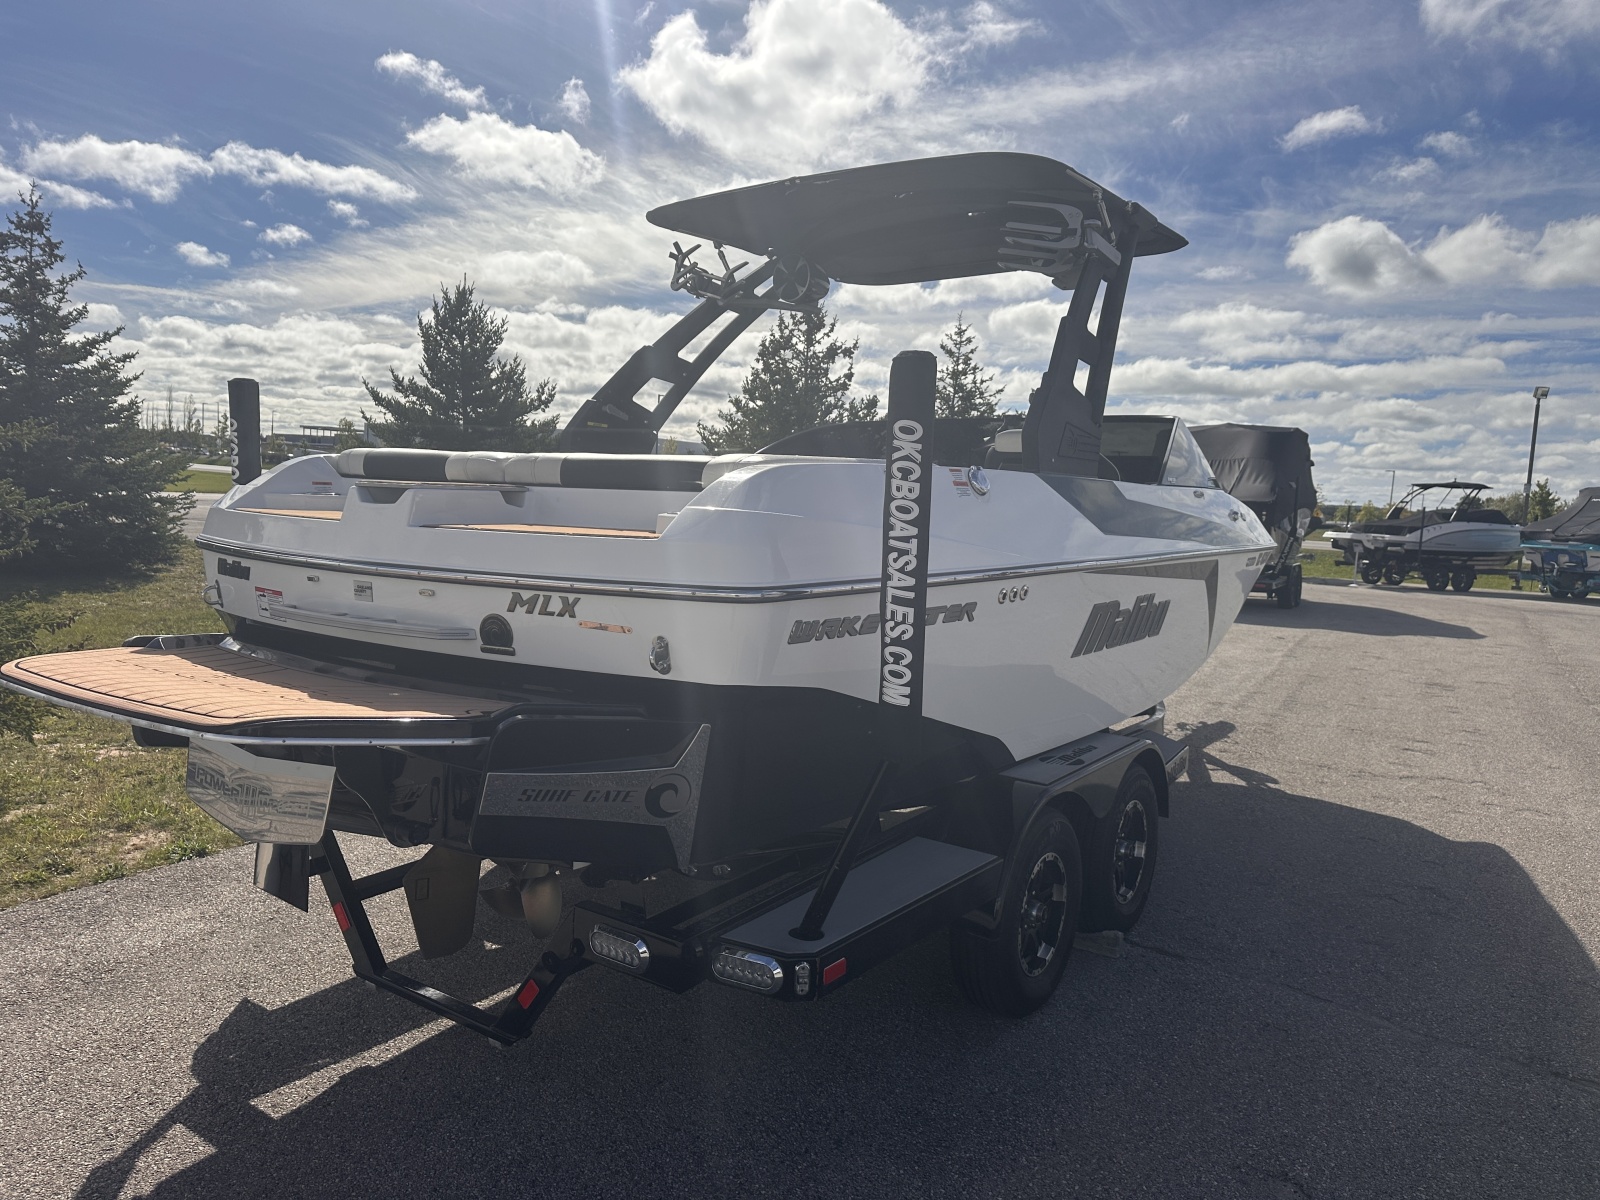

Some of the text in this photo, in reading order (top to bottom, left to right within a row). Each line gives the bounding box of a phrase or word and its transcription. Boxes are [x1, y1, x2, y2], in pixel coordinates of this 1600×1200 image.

[882, 419, 923, 707] OKCBOATSALES.COM
[506, 591, 582, 618] MLX
[787, 601, 978, 644] WAKETER
[1070, 592, 1171, 659] Malibu
[517, 788, 639, 803] SURF GATE
